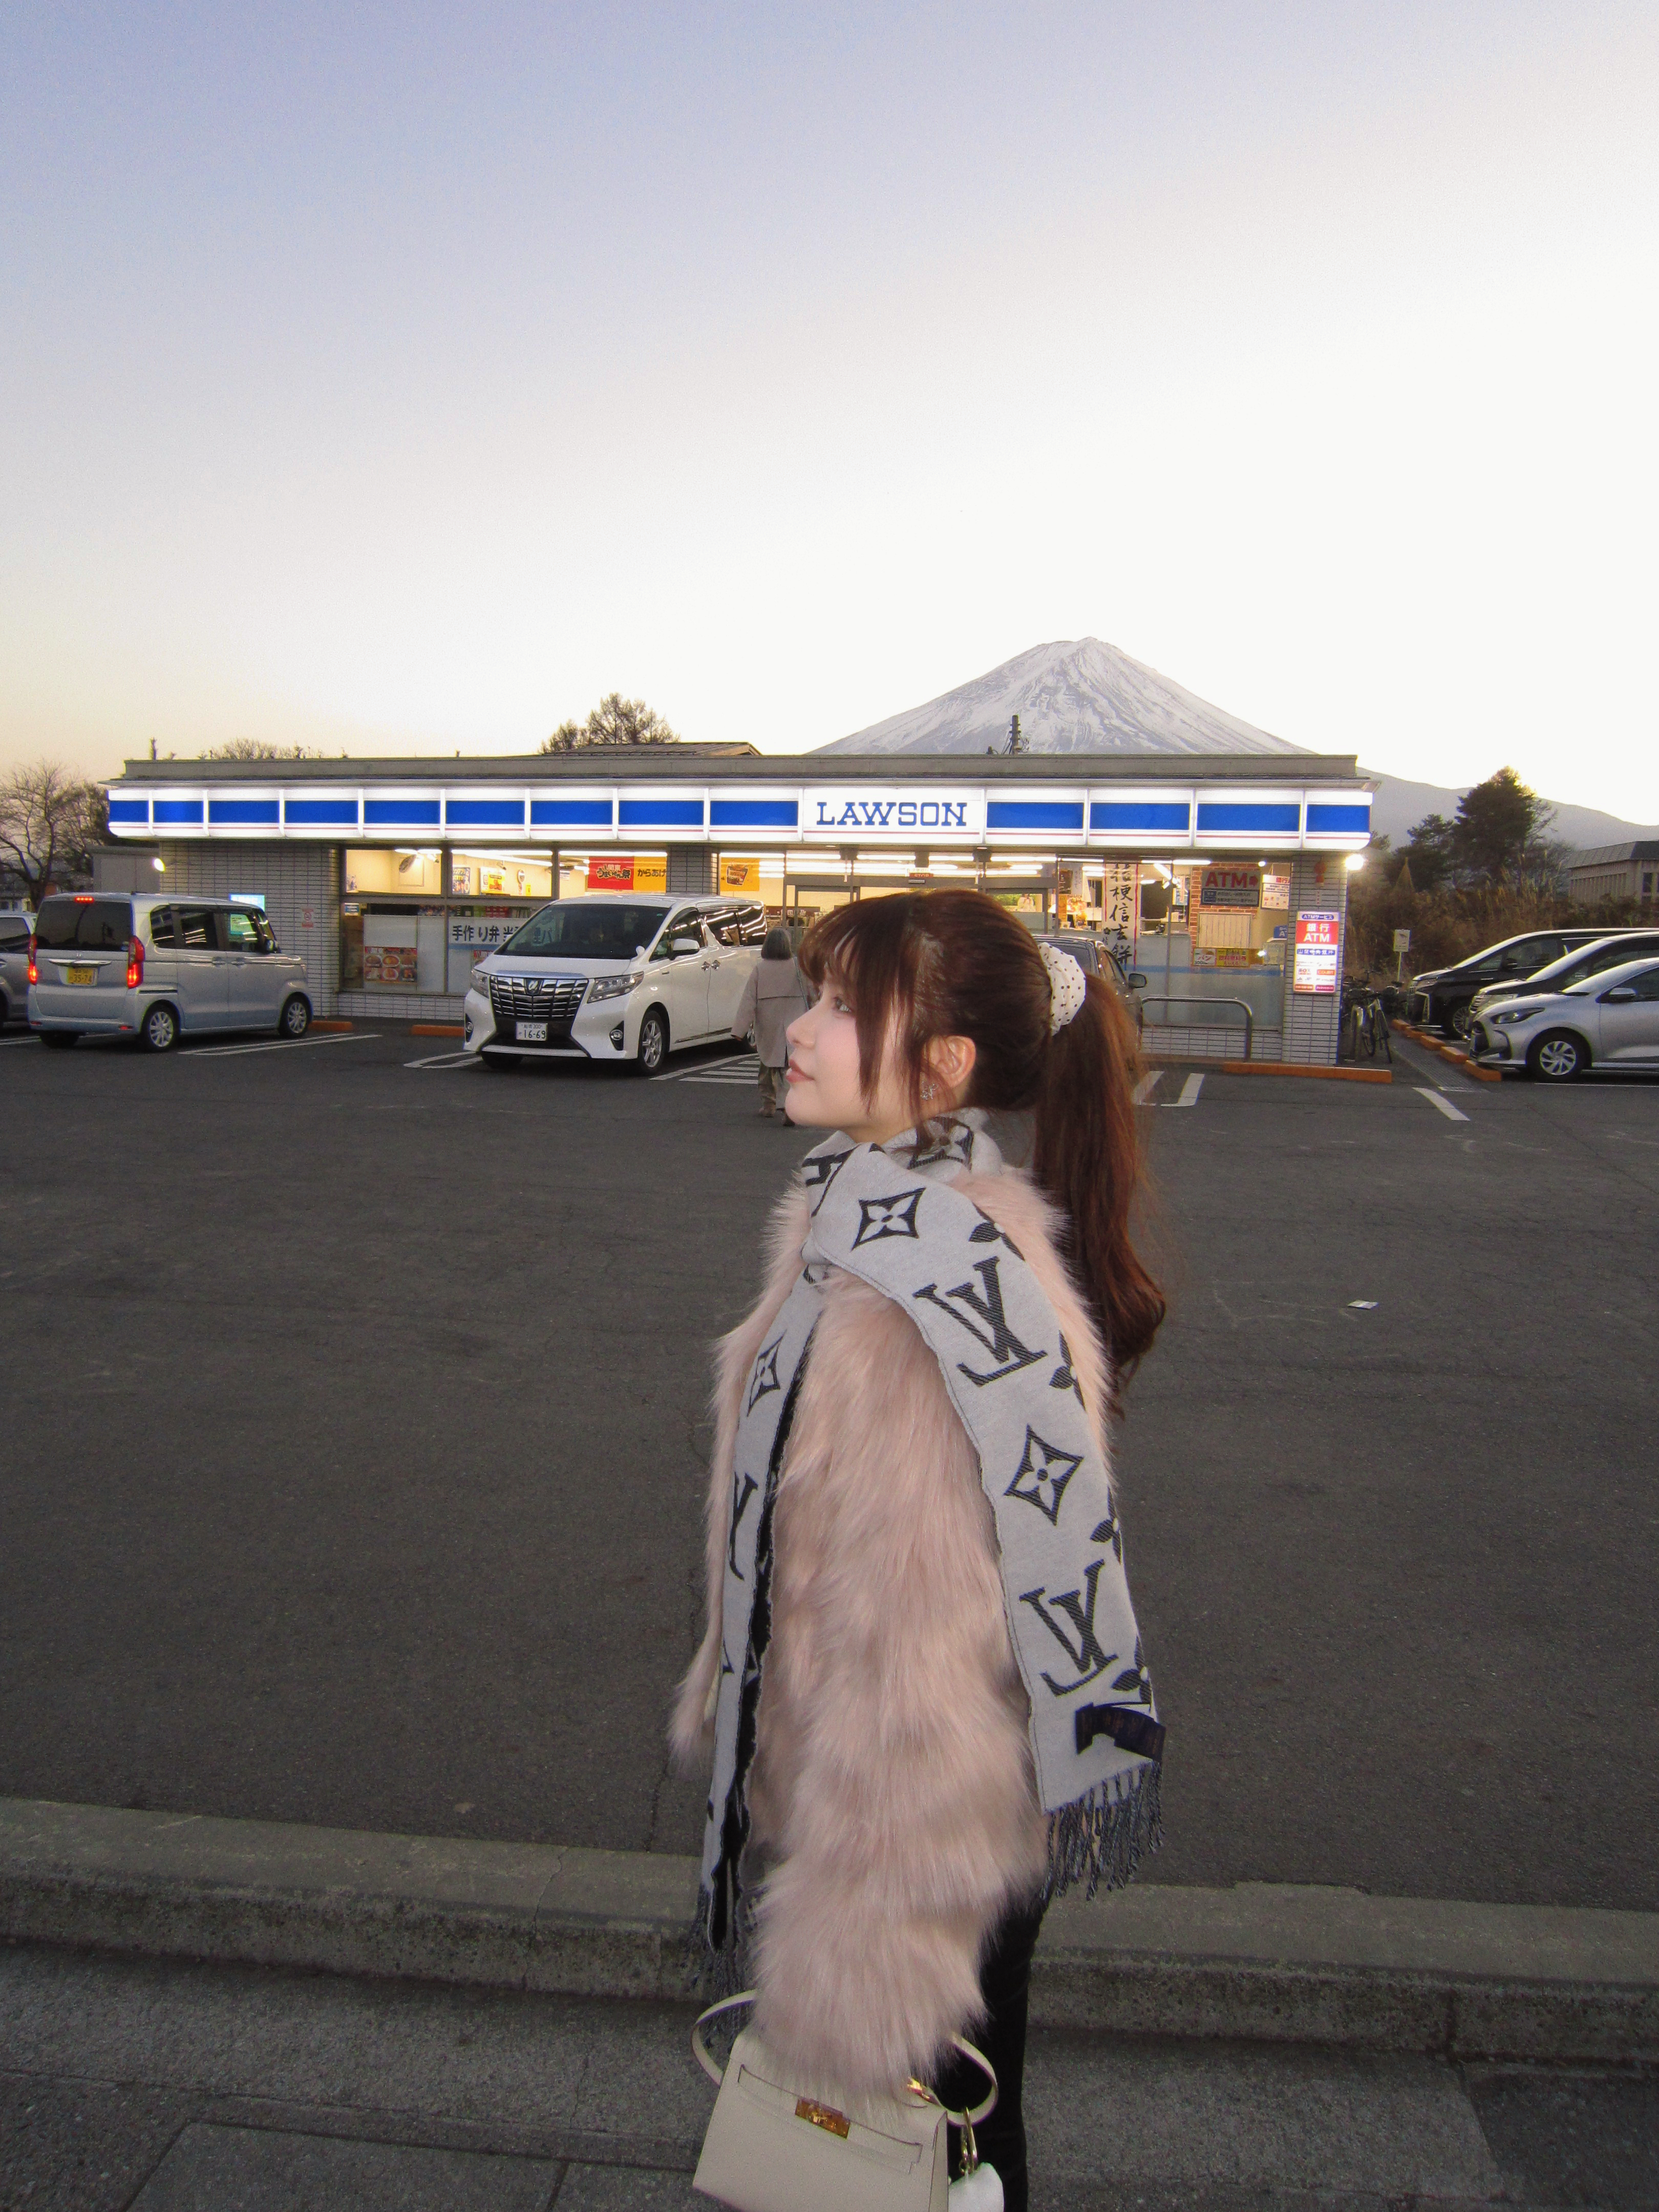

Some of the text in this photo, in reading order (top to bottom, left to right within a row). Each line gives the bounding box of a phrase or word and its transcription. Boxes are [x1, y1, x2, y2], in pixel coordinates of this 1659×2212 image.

[816, 801, 967, 826] LAWSON
[1205, 871, 1248, 888] ATM
[1306, 923, 1330, 932] 銀行
[1303, 933, 1330, 942] ATM
[524, 1030, 546, 1039] 16-69
